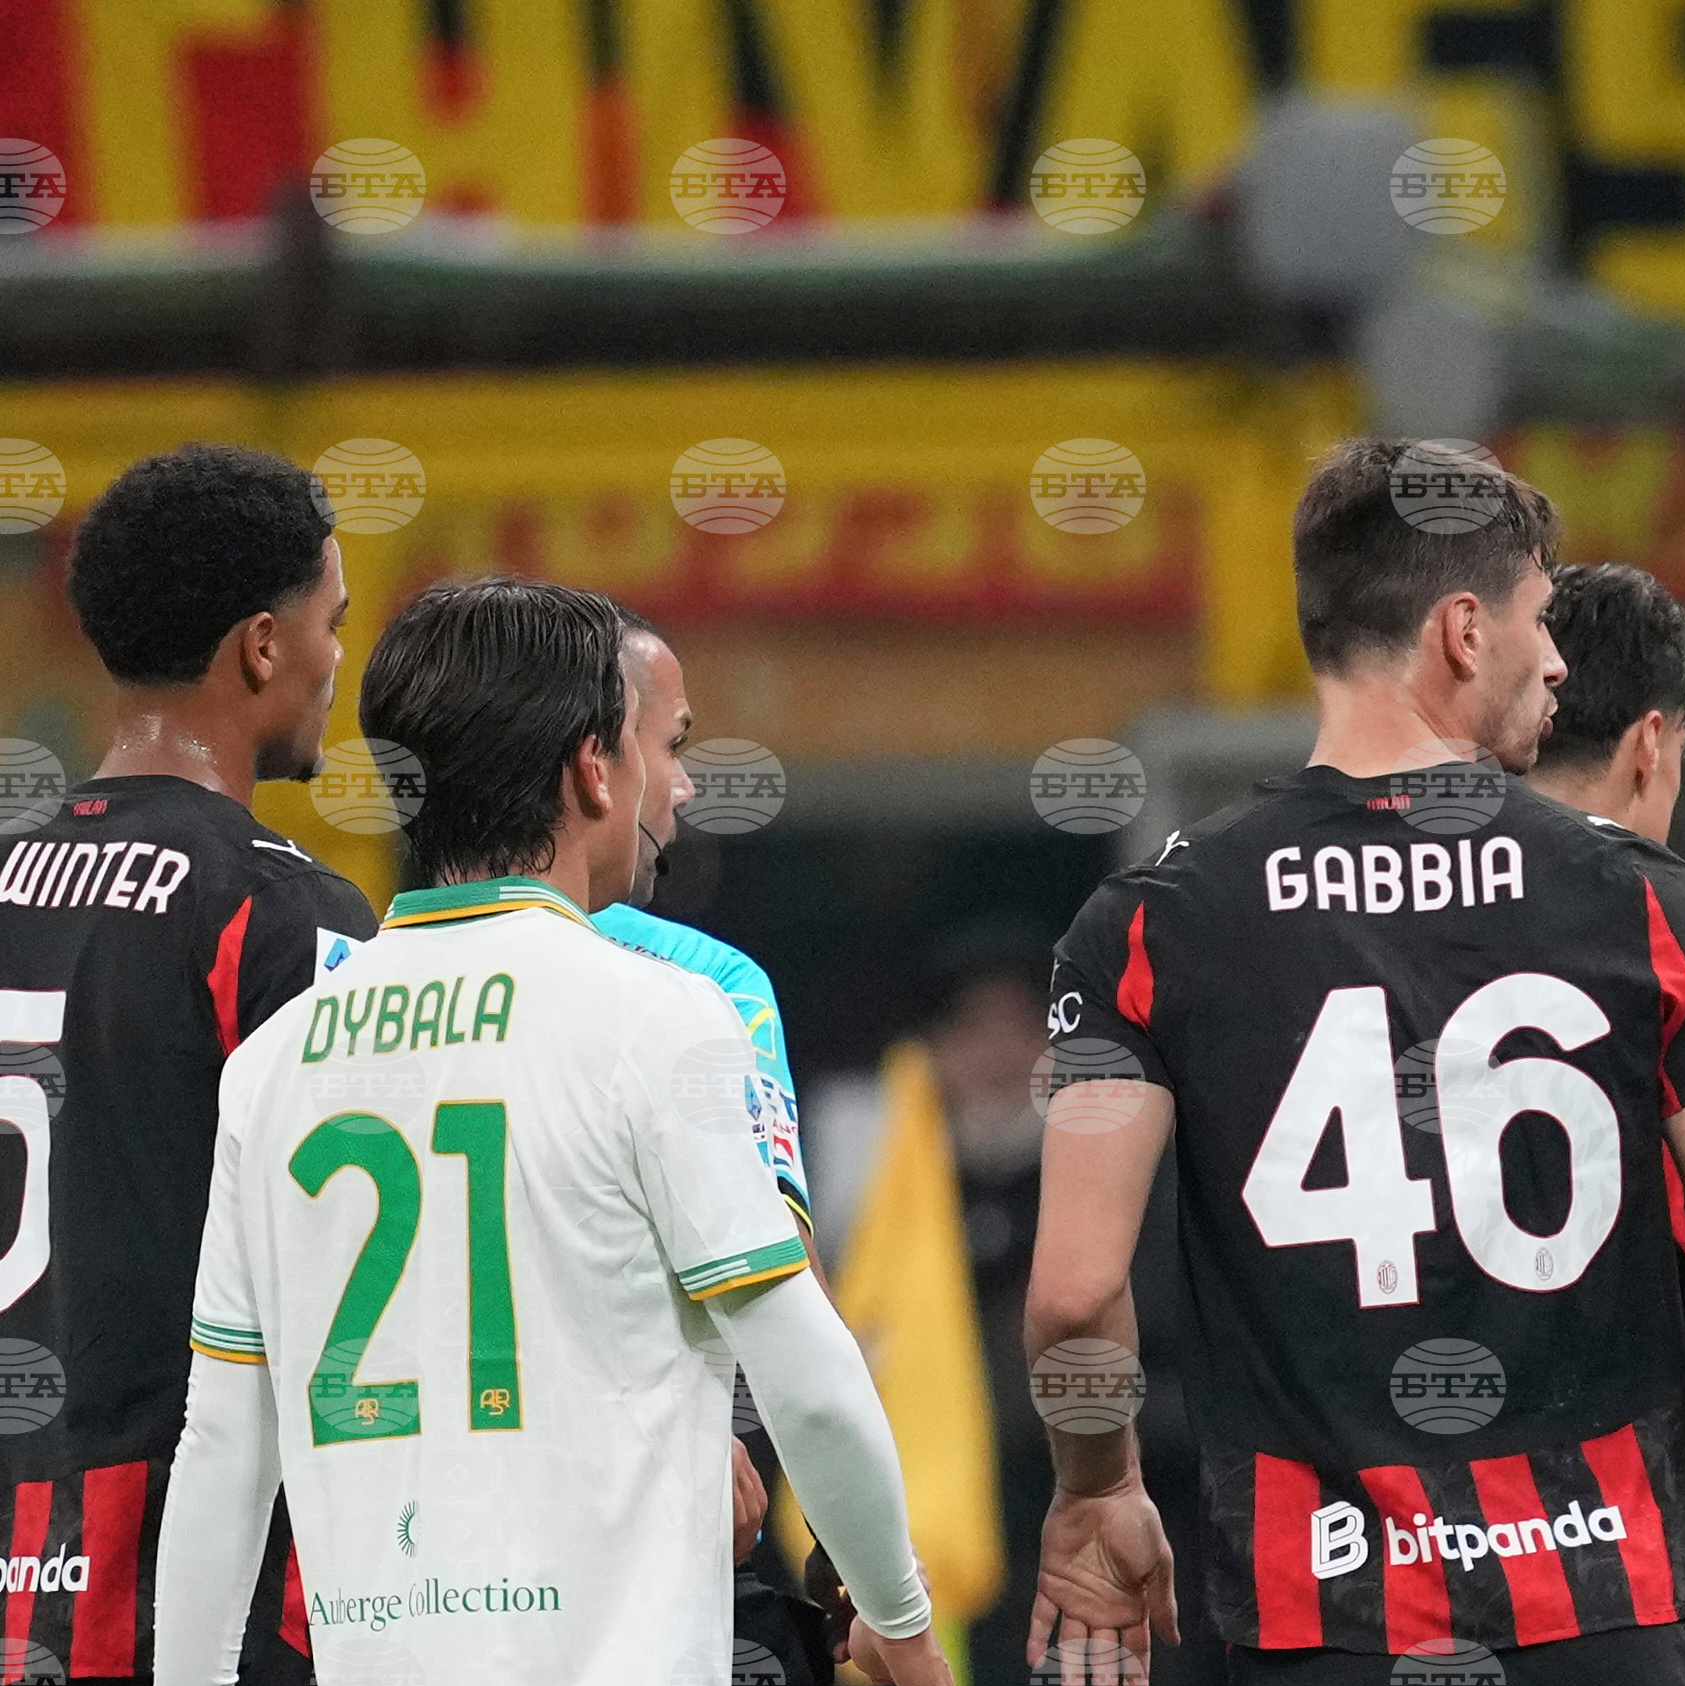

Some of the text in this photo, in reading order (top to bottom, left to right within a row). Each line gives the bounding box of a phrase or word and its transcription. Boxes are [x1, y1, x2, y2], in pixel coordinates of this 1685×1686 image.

[0, 841, 190, 914] WINTER
[1265, 836, 1524, 914] GABBIA
[301, 973, 516, 1064] DYBALA
[1242, 972, 1622, 1309] 46
[288, 1099, 525, 1448] 21
[1384, 1500, 1628, 1572] bitpanda
[308, 1577, 562, 1632] Auberge Collection
